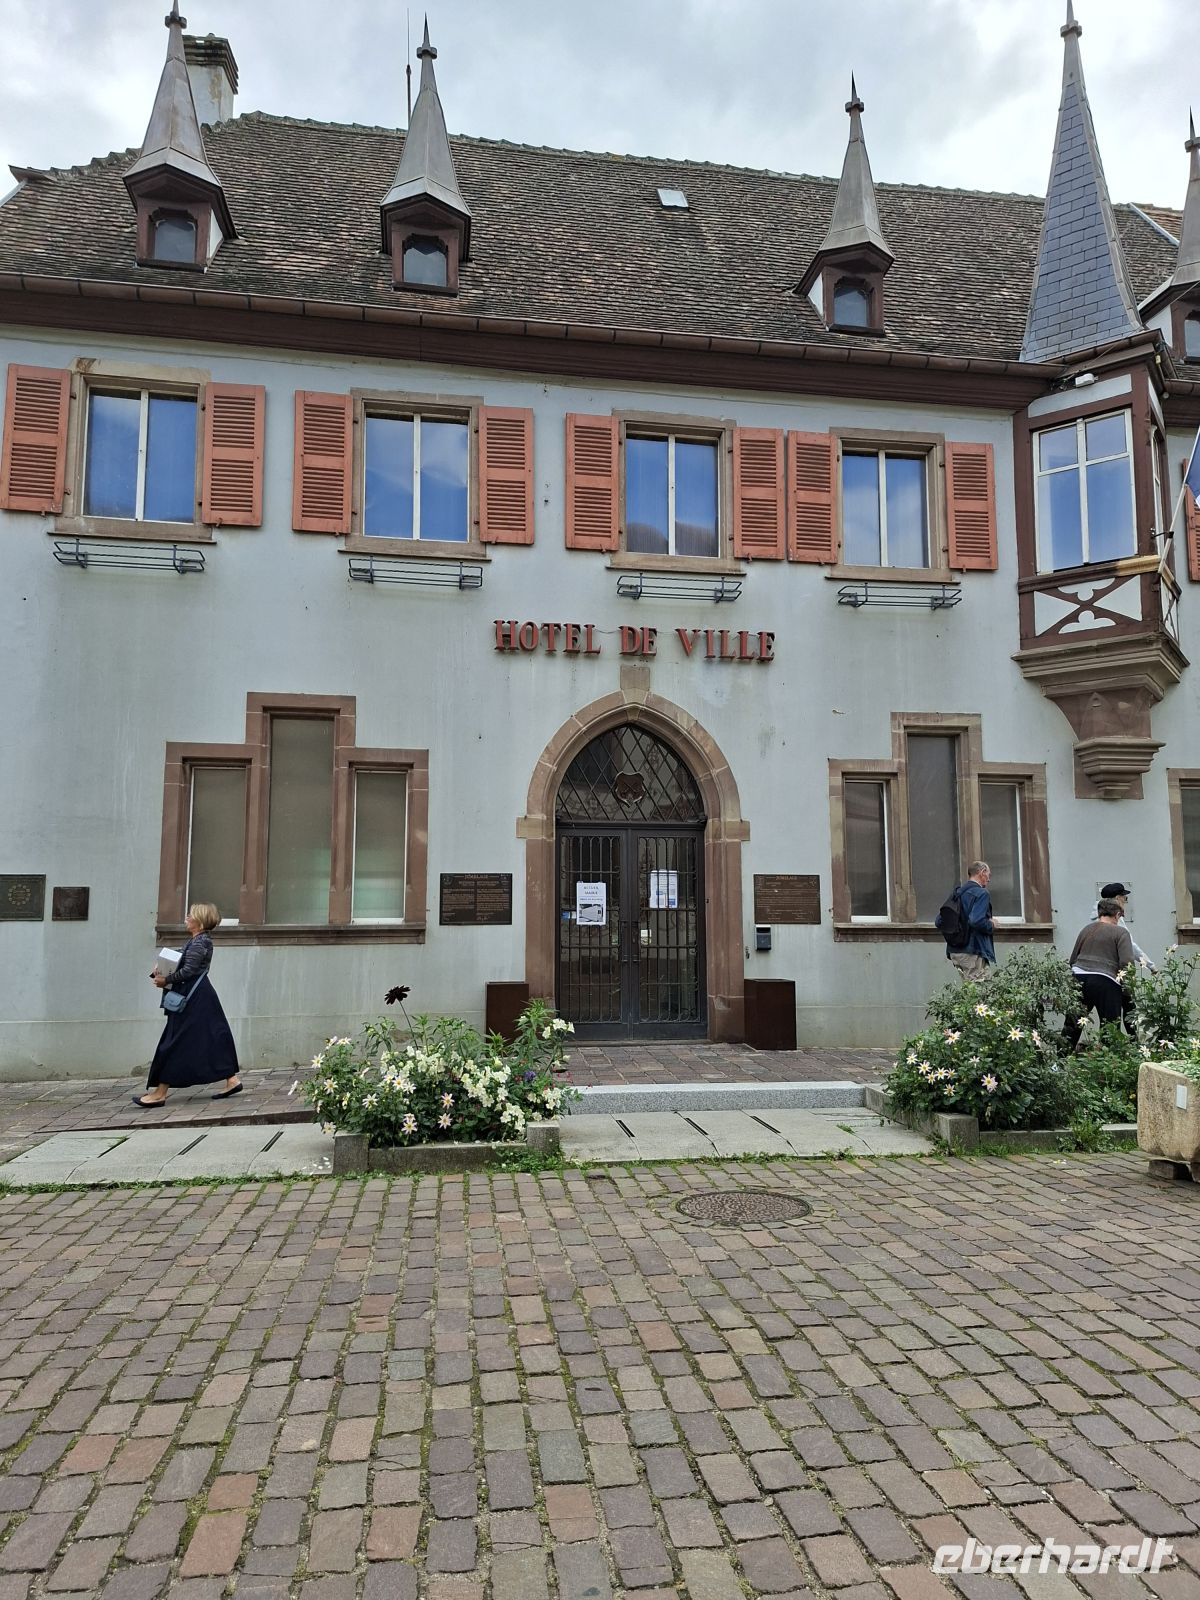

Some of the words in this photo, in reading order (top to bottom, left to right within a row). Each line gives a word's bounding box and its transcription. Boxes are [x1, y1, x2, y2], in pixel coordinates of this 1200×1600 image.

[493, 619, 602, 654] HOTEL
[618, 625, 658, 656] DE
[674, 628, 776, 661] VILLE
